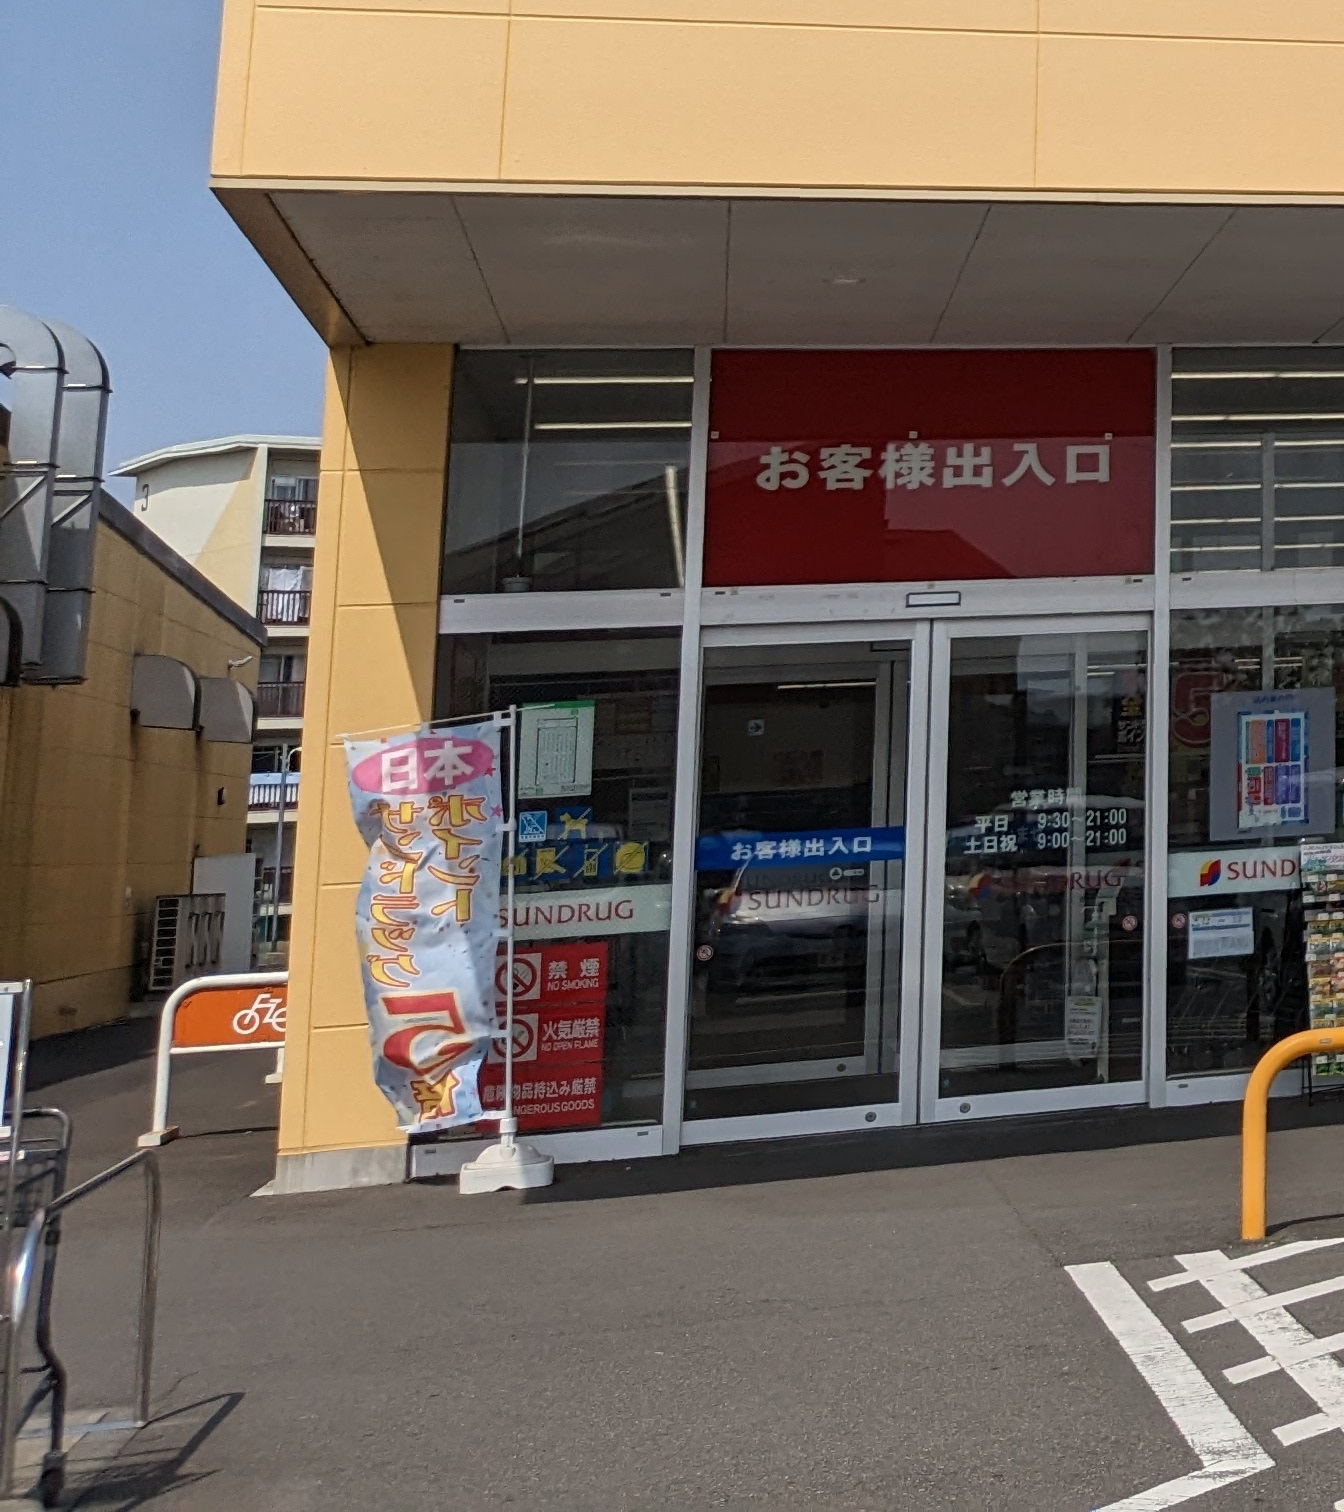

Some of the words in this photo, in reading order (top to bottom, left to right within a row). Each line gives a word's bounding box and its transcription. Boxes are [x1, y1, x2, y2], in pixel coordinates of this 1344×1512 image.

[756, 442, 1111, 491] お客様出入口
[974, 814, 1009, 834] 平日
[730, 836, 873, 861] お客様出入口
[963, 834, 1018, 855] 土日祝
[1227, 858, 1297, 881] SUND
[748, 884, 880, 912] SUNDRUG
[499, 899, 634, 927] SUNDRUG
[547, 982, 560, 992] NO
[562, 978, 600, 991] SMOKING
[553, 1040, 573, 1052] OPEN
[574, 1038, 600, 1050] FLAME
[512, 1104, 560, 1116] NGEROUS
[560, 1098, 596, 1112] GOODS
